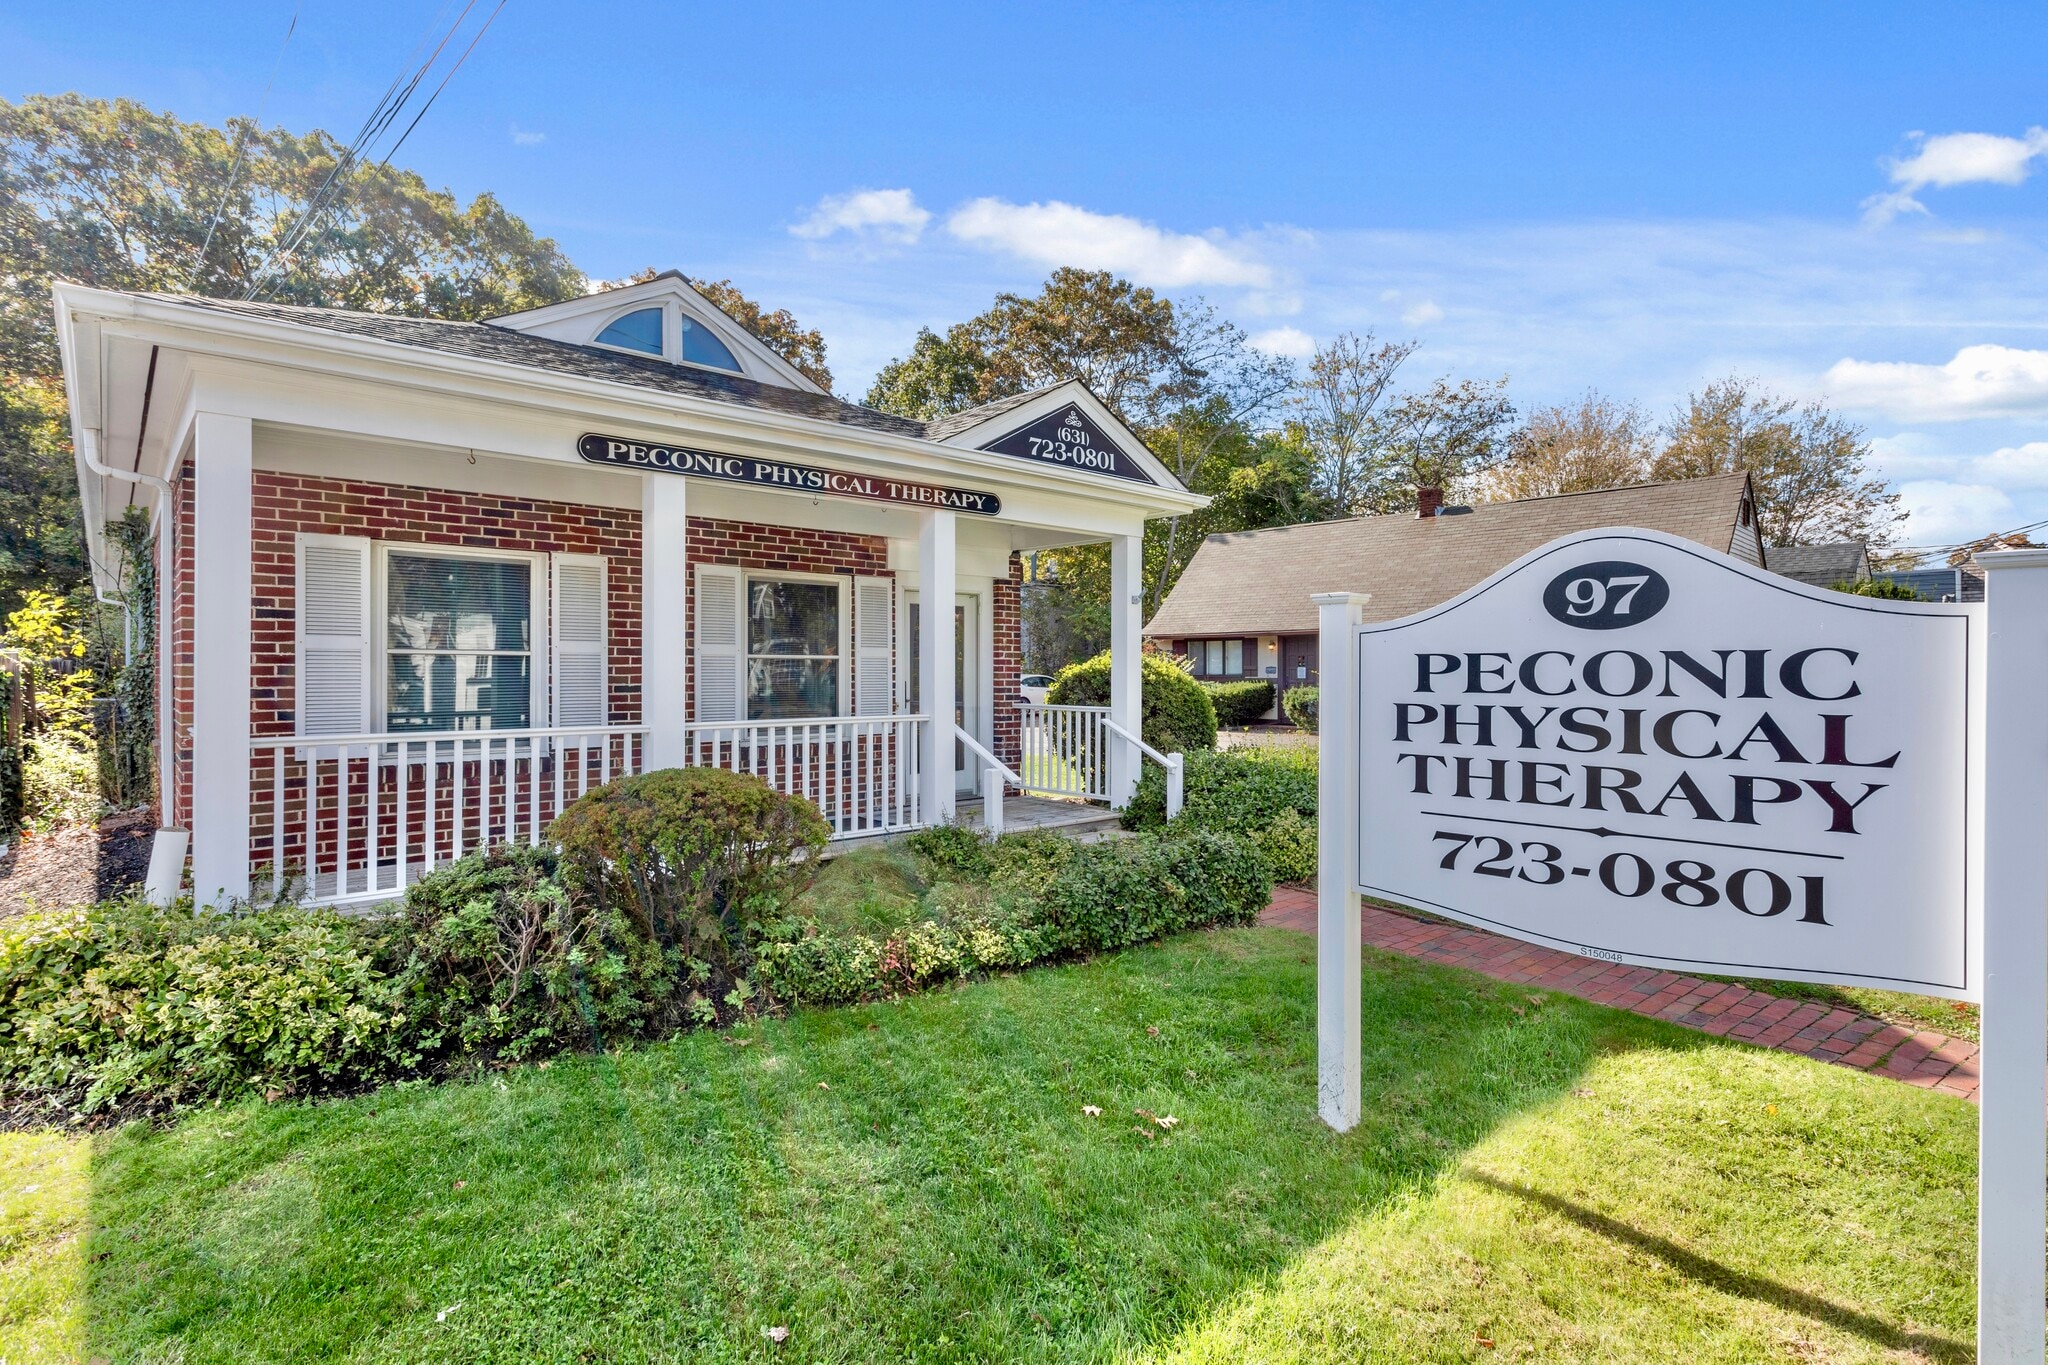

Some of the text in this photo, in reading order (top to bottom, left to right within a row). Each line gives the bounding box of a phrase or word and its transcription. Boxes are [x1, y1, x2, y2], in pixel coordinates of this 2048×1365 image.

[1028, 437, 1116, 471] 723-0801
[1057, 427, 1090, 446] (631)
[606, 440, 987, 510] PECONIC PHYSICAL THERAPY
[1564, 575, 1650, 616] 97
[1414, 647, 1862, 701] PECONIC
[1392, 702, 1902, 768] PHYSICAL
[1396, 753, 1890, 835] THERAPY
[1431, 830, 1834, 927] 723-0801
[1580, 947, 1623, 962] S150048
